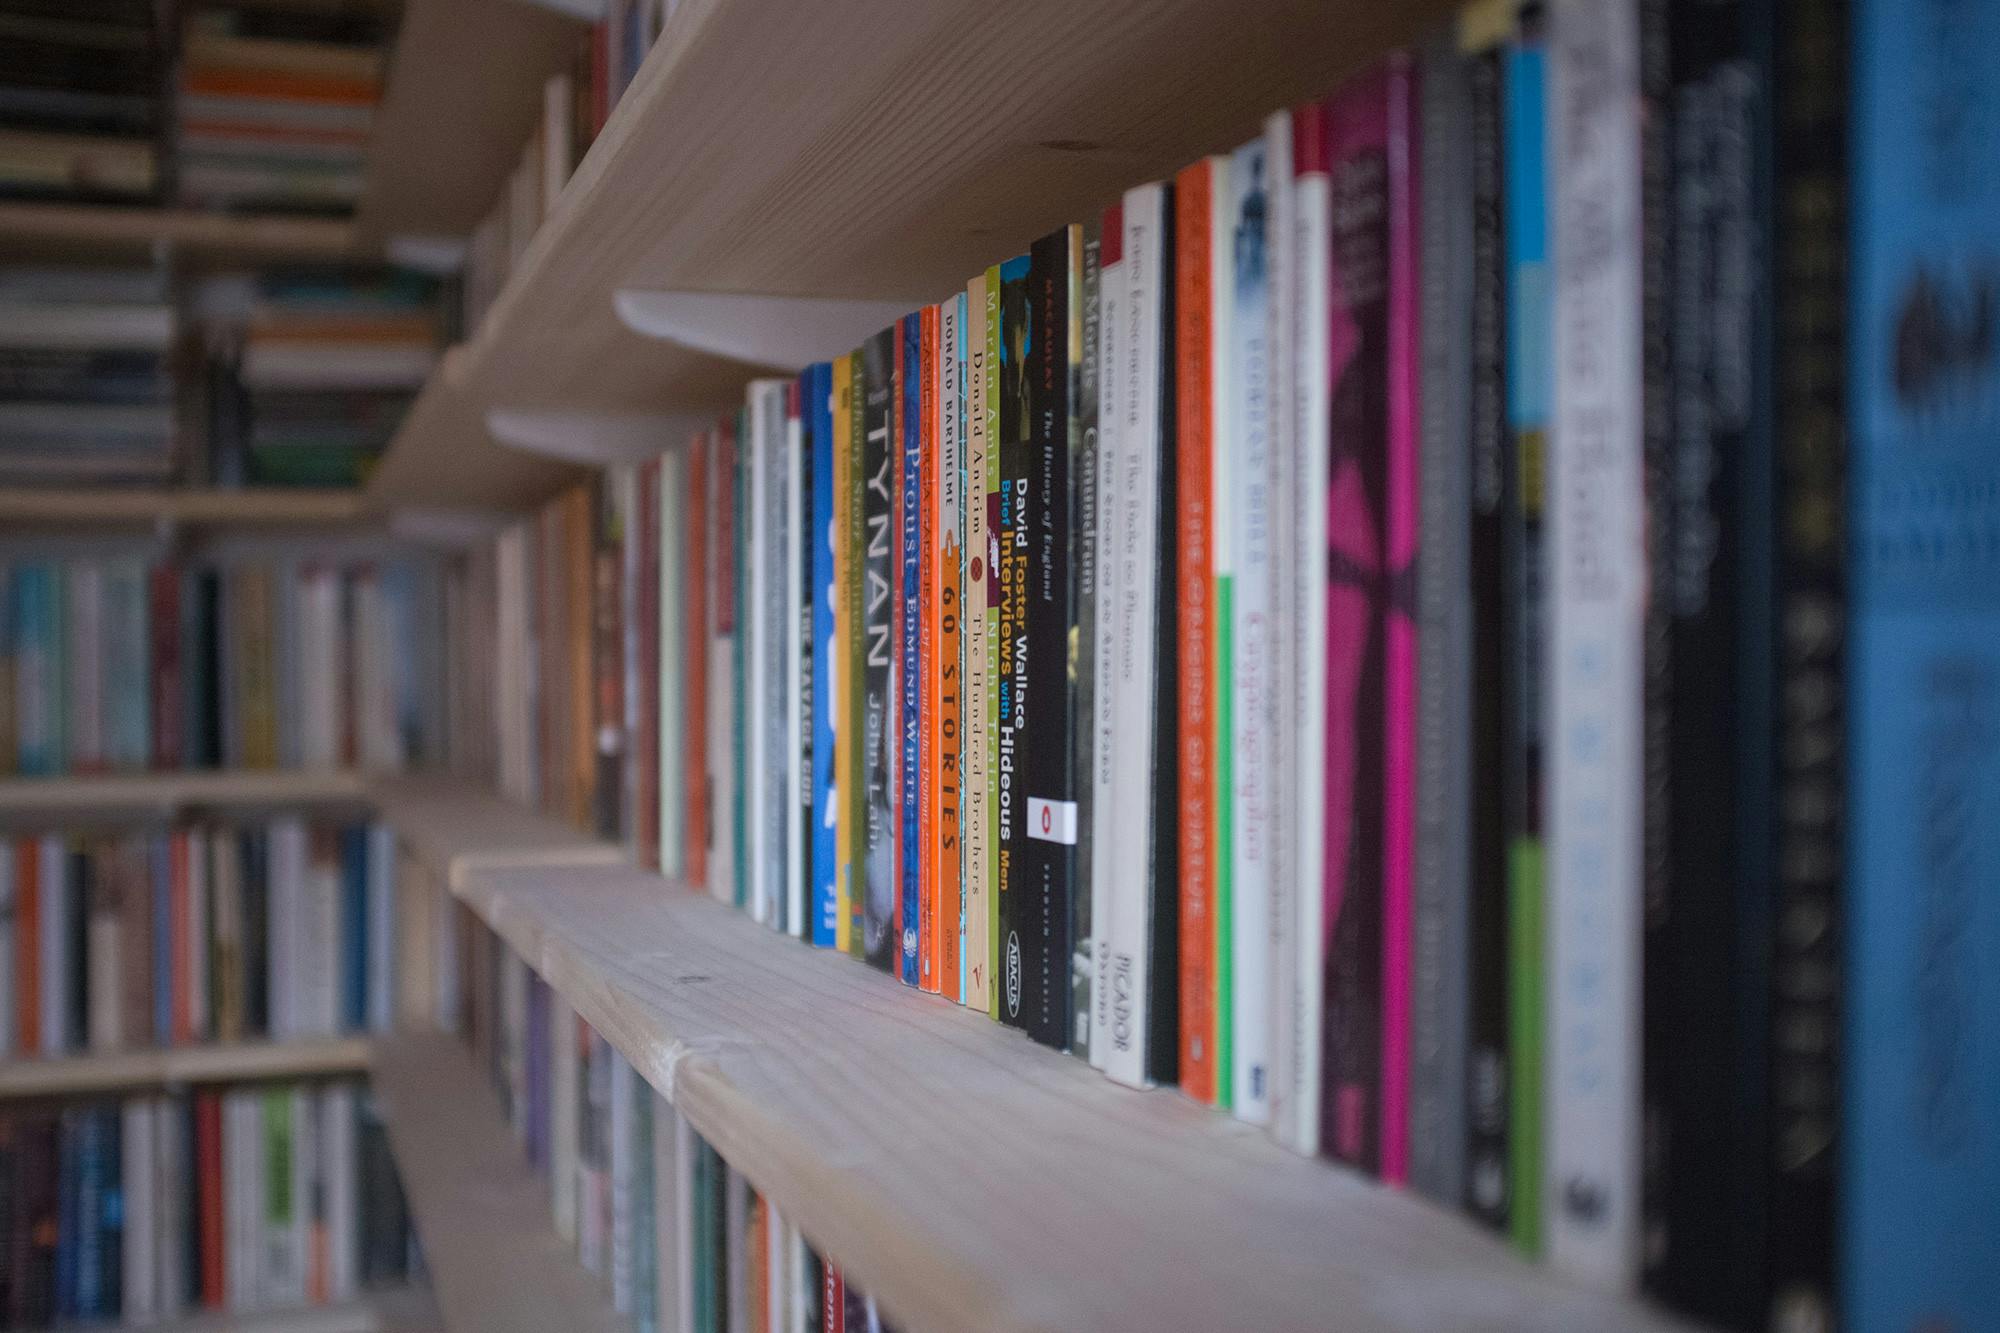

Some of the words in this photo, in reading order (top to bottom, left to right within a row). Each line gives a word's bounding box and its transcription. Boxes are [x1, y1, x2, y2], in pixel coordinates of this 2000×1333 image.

[945, 314, 953, 390] DONALD
[987, 291, 996, 388] Martin
[1084, 295, 1100, 390] Morris
[851, 363, 863, 466] Anthony
[973, 351, 983, 437] Donald
[1043, 409, 1053, 438] The
[945, 400, 953, 507] BARTHELME
[986, 408, 996, 478] Amis
[1041, 446, 1053, 504] History
[852, 479, 864, 541] Storr
[905, 444, 920, 569] Proust
[973, 449, 983, 535] Antrim
[1000, 479, 1011, 527] Brief
[1015, 477, 1028, 548] David
[1041, 511, 1053, 528] of
[1082, 426, 1098, 595] Conundrum
[867, 409, 889, 667] TYNAN
[1041, 535, 1053, 603] England
[802, 604, 812, 646] THE
[852, 549, 864, 656] Solitude
[943, 586, 955, 634] 60
[1000, 531, 1014, 676] Interviews
[1015, 556, 1028, 630] Foster
[906, 596, 917, 707] EDMUND
[973, 612, 983, 657] The
[987, 621, 997, 701] Night
[802, 656, 812, 749] SAVAGE
[1000, 681, 1011, 719] with
[1015, 635, 1028, 729] Wallace
[868, 692, 881, 767] John
[906, 719, 917, 806] WHITE
[943, 664, 955, 852] STORIES
[972, 671, 981, 777] Hundred
[987, 718, 997, 794] Train
[802, 759, 812, 807] GOD
[868, 784, 881, 851] Lahr
[1000, 725, 1014, 841] Hideous
[972, 791, 981, 897] Brothers
[1000, 850, 1010, 891] Men
[1009, 941, 1018, 1007] ABACUS
